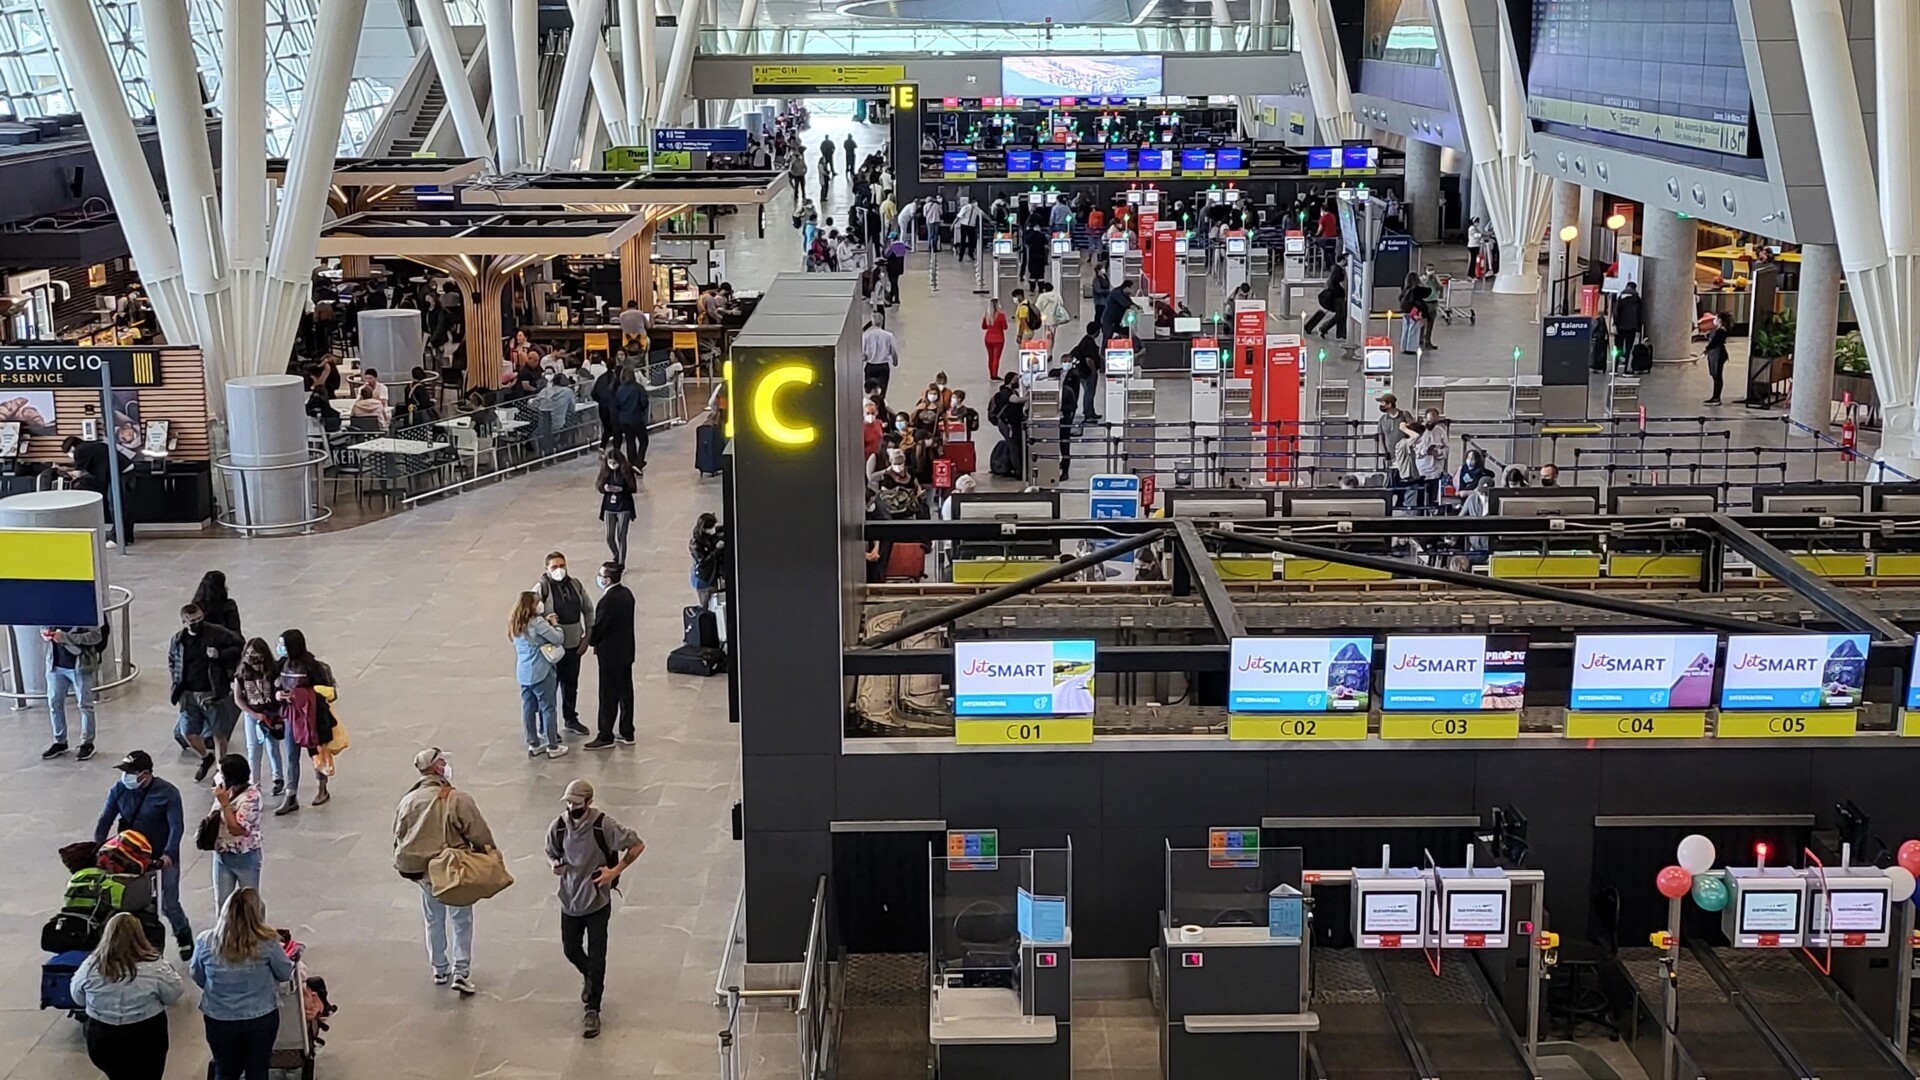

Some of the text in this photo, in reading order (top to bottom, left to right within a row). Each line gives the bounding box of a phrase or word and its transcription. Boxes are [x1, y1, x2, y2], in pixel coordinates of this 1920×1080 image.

[899, 86, 914, 108] E
[3, 355, 102, 371] SERVICIO
[0, 373, 64, 383] F-SERVICE
[754, 366, 815, 444] C
[963, 659, 1046, 678] JetSMART
[1238, 655, 1322, 674] JetSMART
[1393, 653, 1478, 672] JetSMART
[1581, 652, 1666, 671] JetSMART
[1733, 653, 1819, 671] JetSMART
[1006, 724, 1041, 740] C01
[1280, 720, 1317, 736] C02
[1431, 719, 1468, 735] C03
[1617, 717, 1655, 733] C04
[1768, 717, 1806, 733] C05
